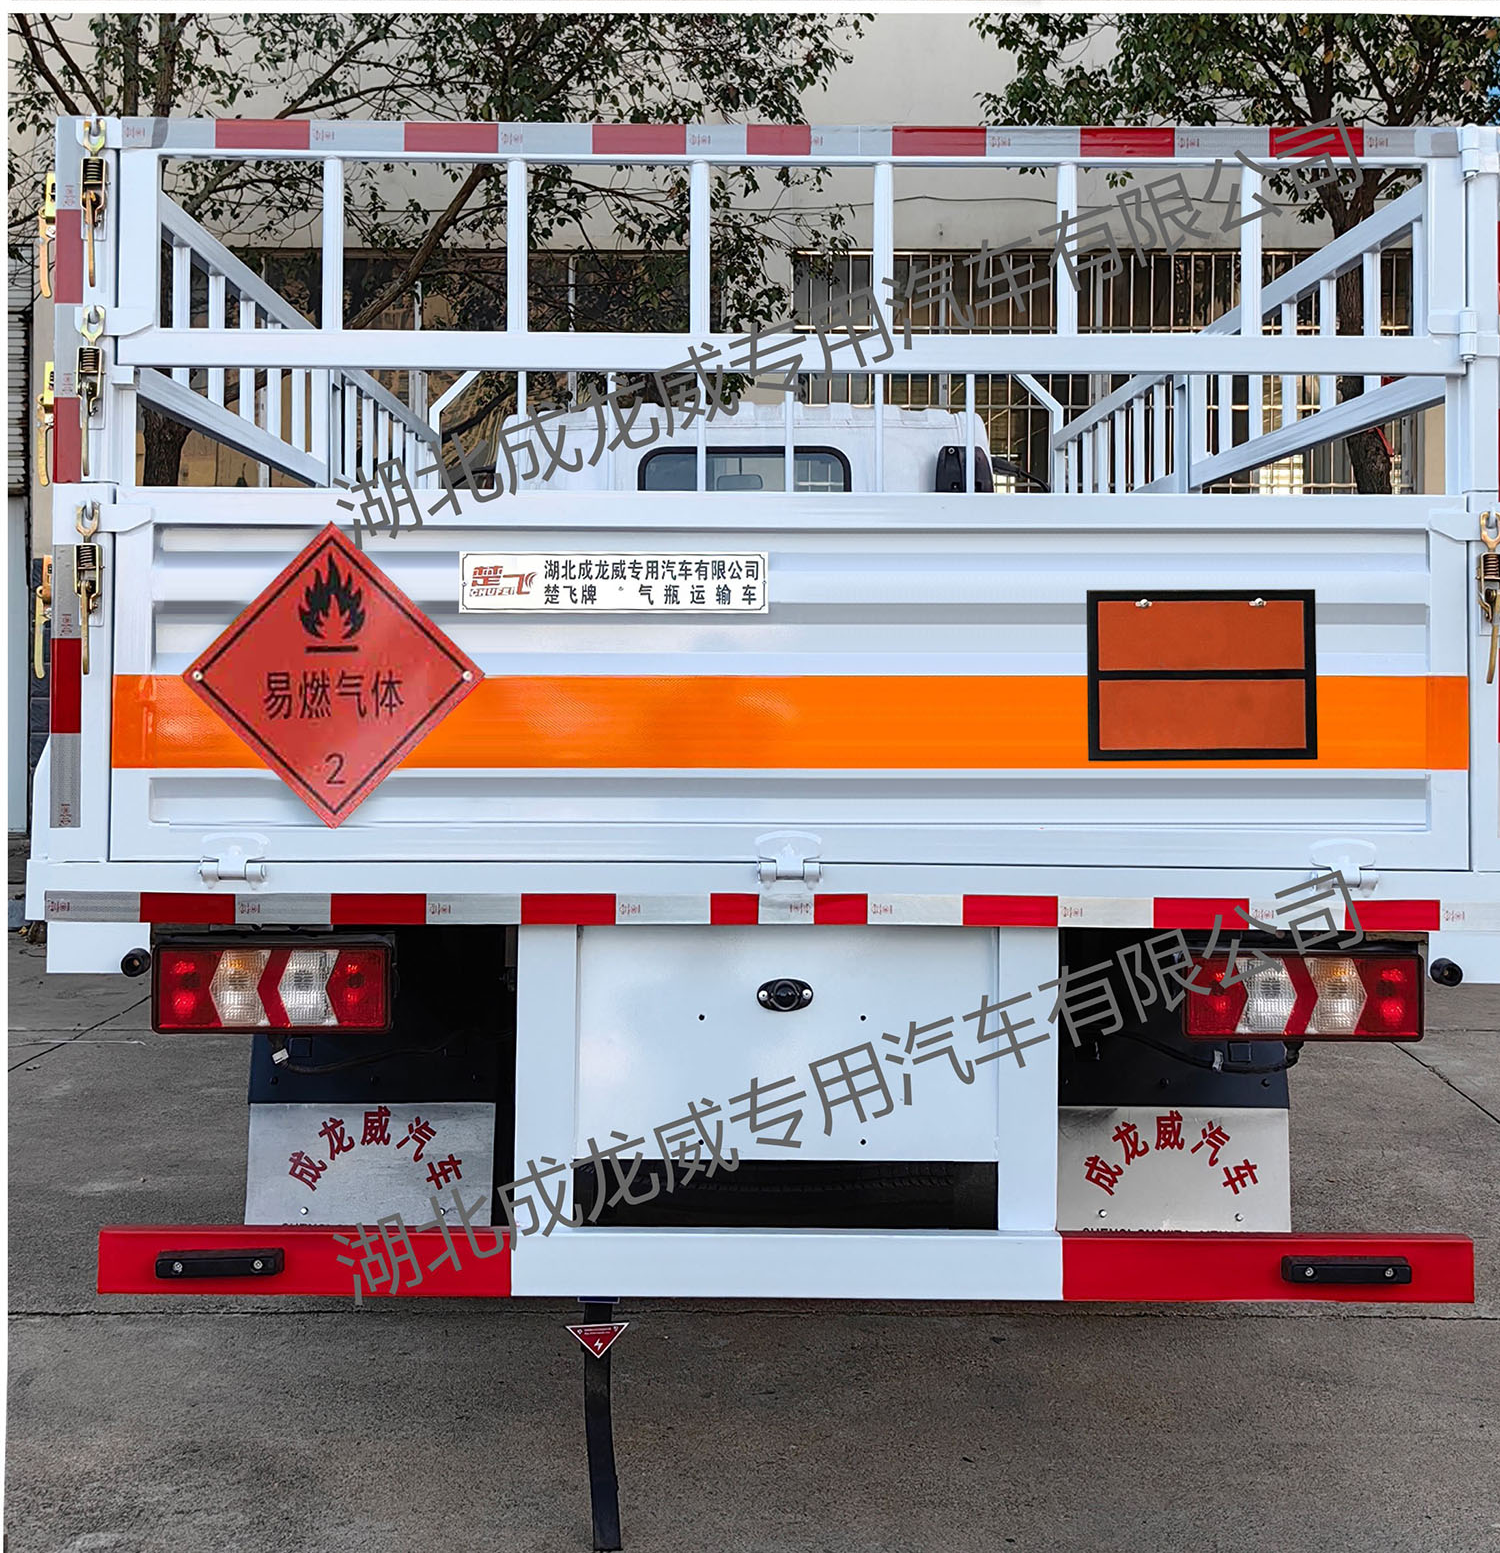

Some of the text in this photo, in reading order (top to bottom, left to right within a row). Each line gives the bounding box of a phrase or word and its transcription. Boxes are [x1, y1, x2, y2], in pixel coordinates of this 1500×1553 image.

[543, 559, 760, 581] 湖北成龙威专用汽车有限公司
[543, 584, 758, 606] 楚飞牌 气瓶运输车
[263, 669, 405, 720] 易燃气体
[324, 752, 346, 785] 2
[288, 1105, 463, 1192] 成龙威汽车
[1084, 1109, 1259, 1196] 成龙威汽车
